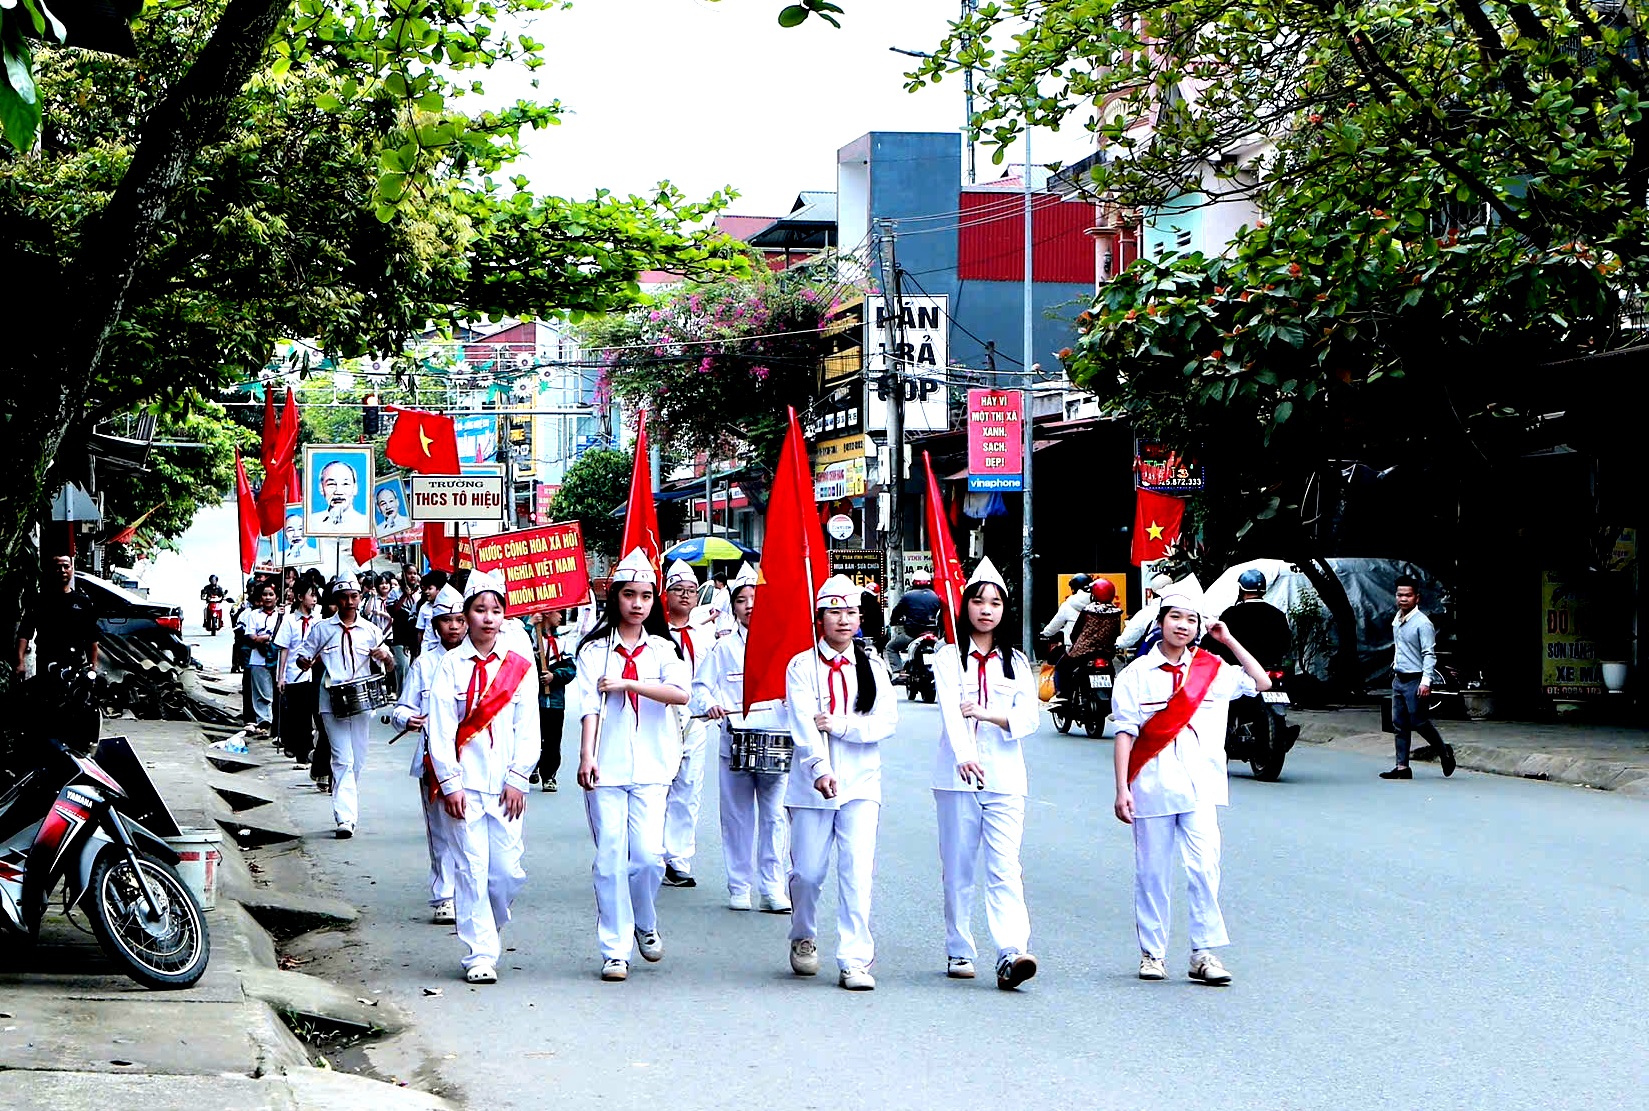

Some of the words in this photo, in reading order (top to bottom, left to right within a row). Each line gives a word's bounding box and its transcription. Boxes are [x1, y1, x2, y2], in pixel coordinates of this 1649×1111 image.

[428, 478, 485, 488] TRƯỜNG
[970, 478, 1021, 489] vinaphone
[415, 492, 448, 506] THCS
[452, 490, 467, 506] TÔ
[471, 490, 500, 509] HIỆU
[479, 541, 503, 562] NƯỚC
[504, 539, 529, 560] CỘNG
[549, 532, 561, 551] XÃ
[562, 529, 579, 551] HỘI
[506, 561, 535, 582] NGHĨA
[534, 557, 554, 579] VIỆT
[554, 556, 577, 574] NAM
[508, 585, 535, 606] MUÔN
[535, 581, 557, 601] NĂM
[1556, 665, 1575, 682] XE
[66, 790, 93, 809] YAMAHA
